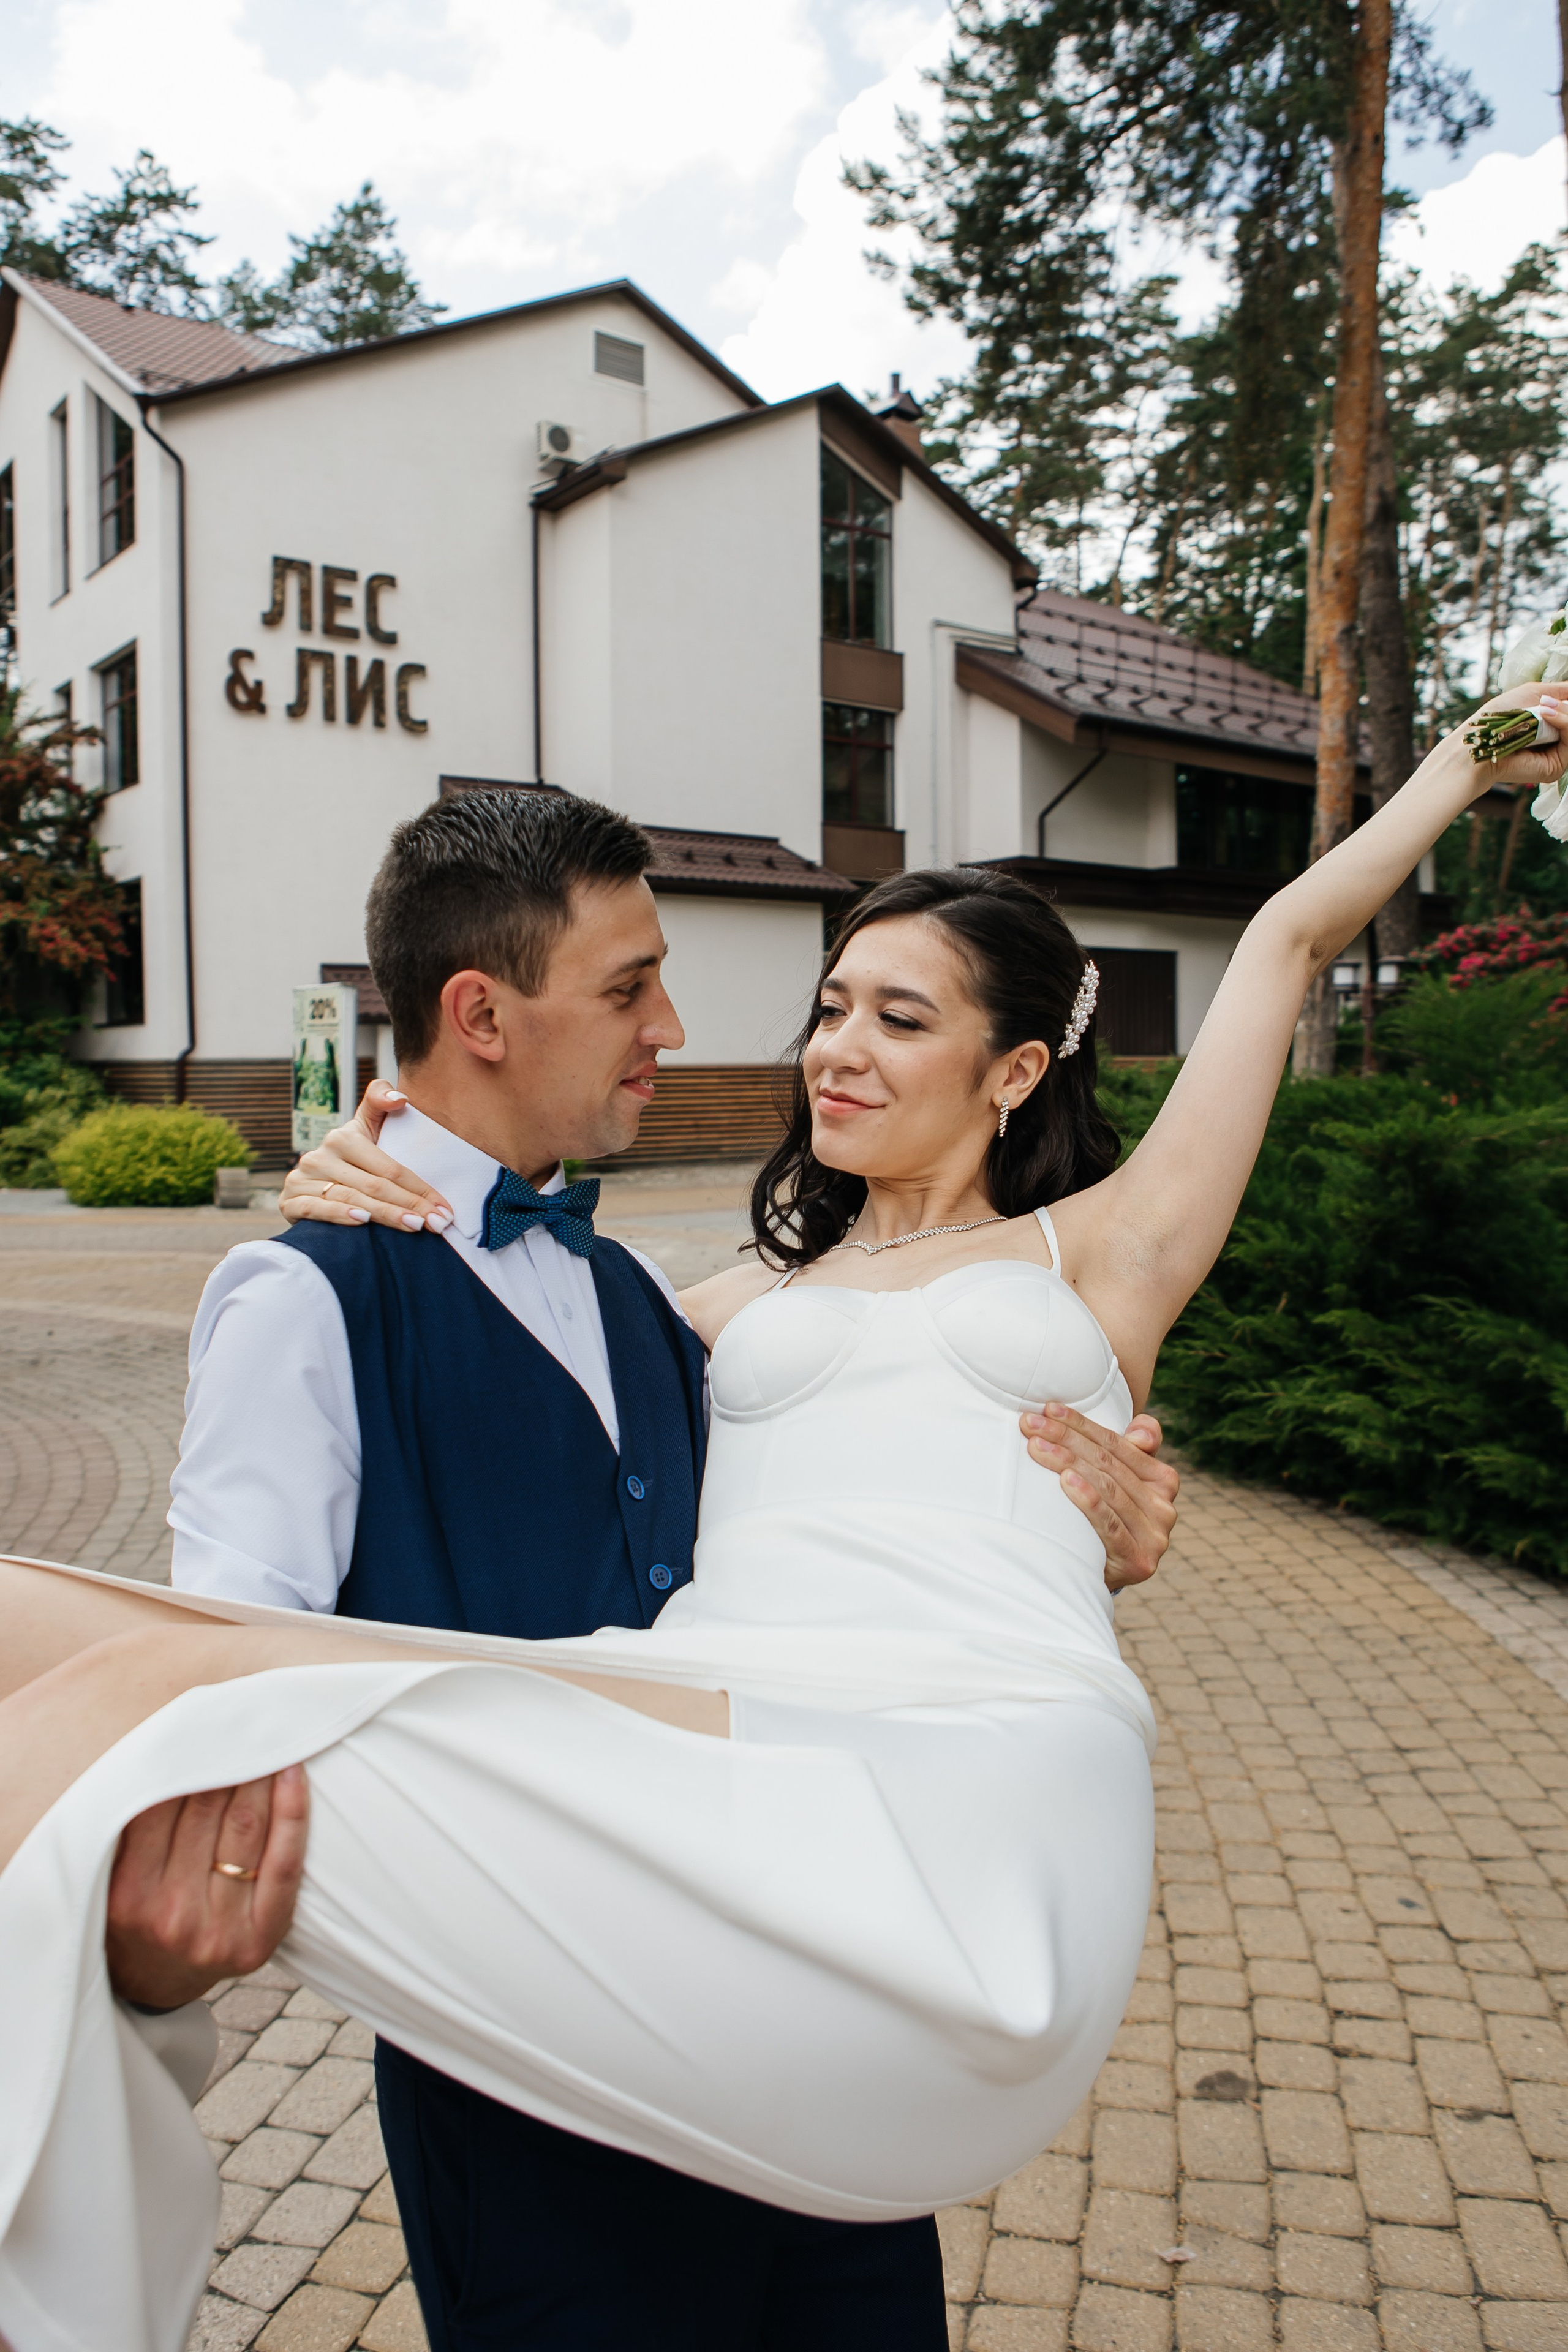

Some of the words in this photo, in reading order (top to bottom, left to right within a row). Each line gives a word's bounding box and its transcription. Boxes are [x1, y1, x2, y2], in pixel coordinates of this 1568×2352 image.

[260, 554, 398, 645] ЛЕС
[225, 647, 266, 715] &
[285, 647, 428, 733] ЛИС
